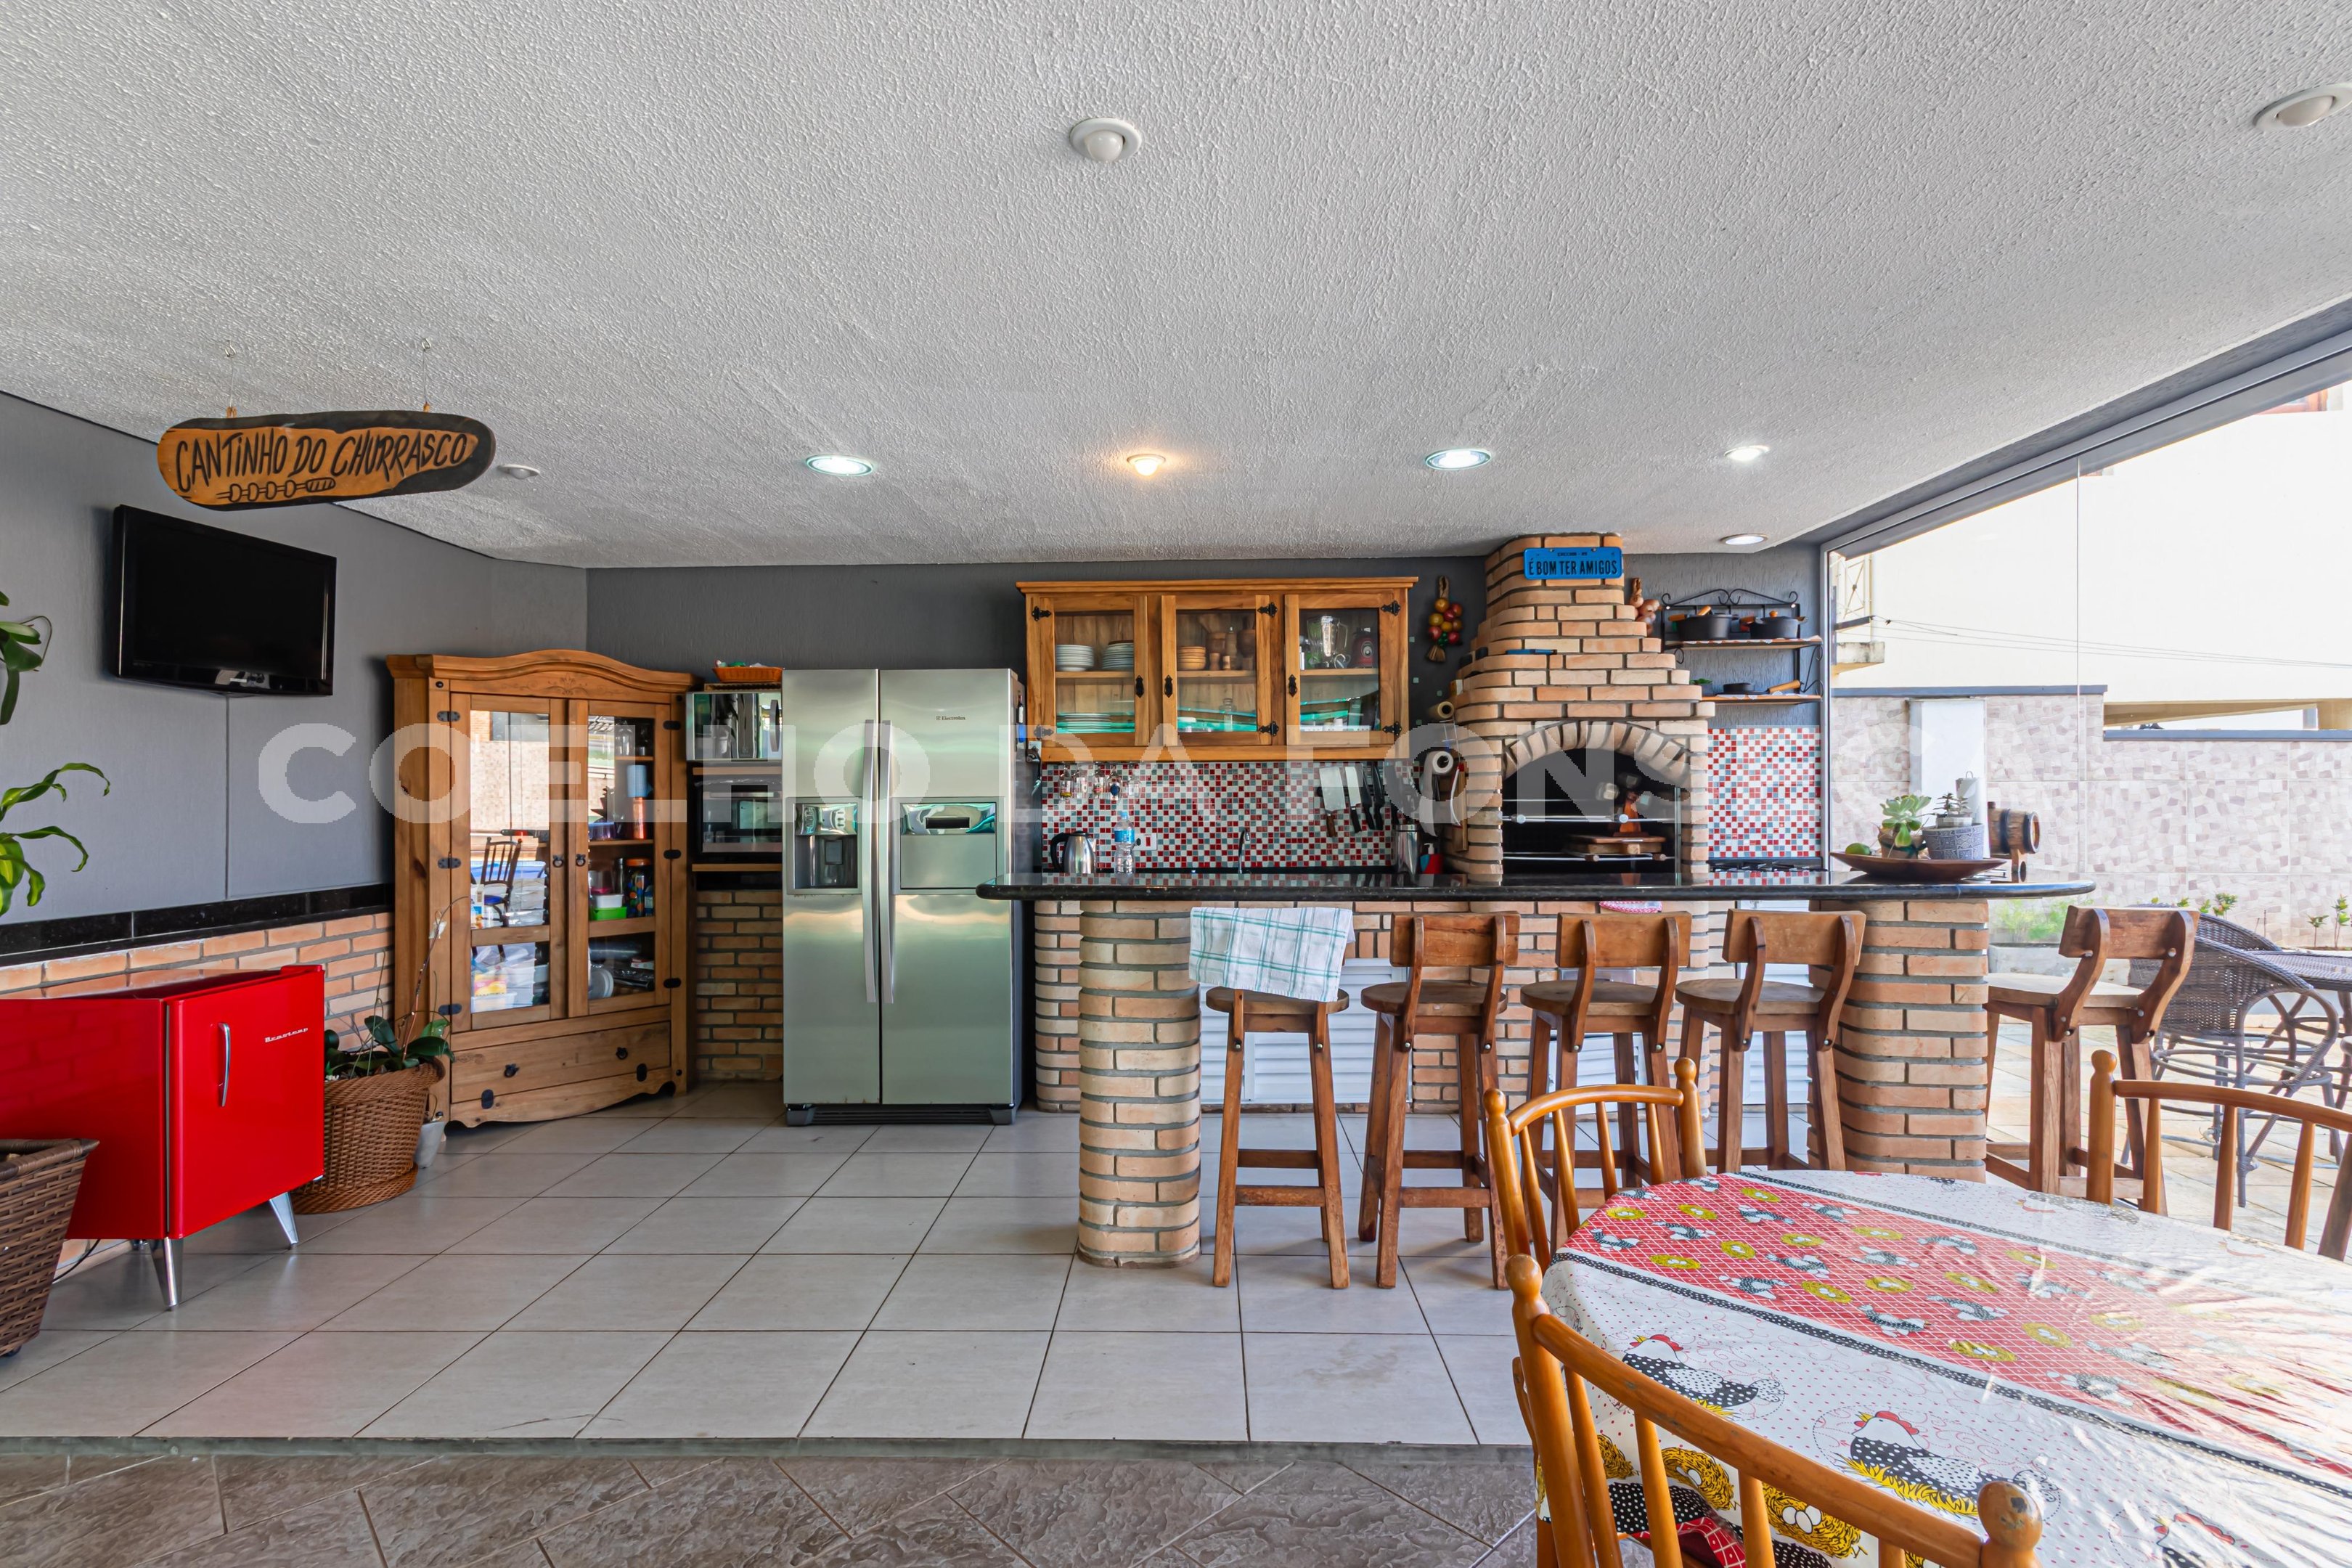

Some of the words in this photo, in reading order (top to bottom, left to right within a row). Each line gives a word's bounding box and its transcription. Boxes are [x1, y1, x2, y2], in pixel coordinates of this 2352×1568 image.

[287, 435, 327, 478] DO
[330, 429, 467, 483] CHURRASCO
[1528, 558, 1535, 576] É
[1536, 560, 1557, 576] BOM
[1559, 560, 1577, 576] TER
[1580, 560, 1617, 576] AMIGOS
